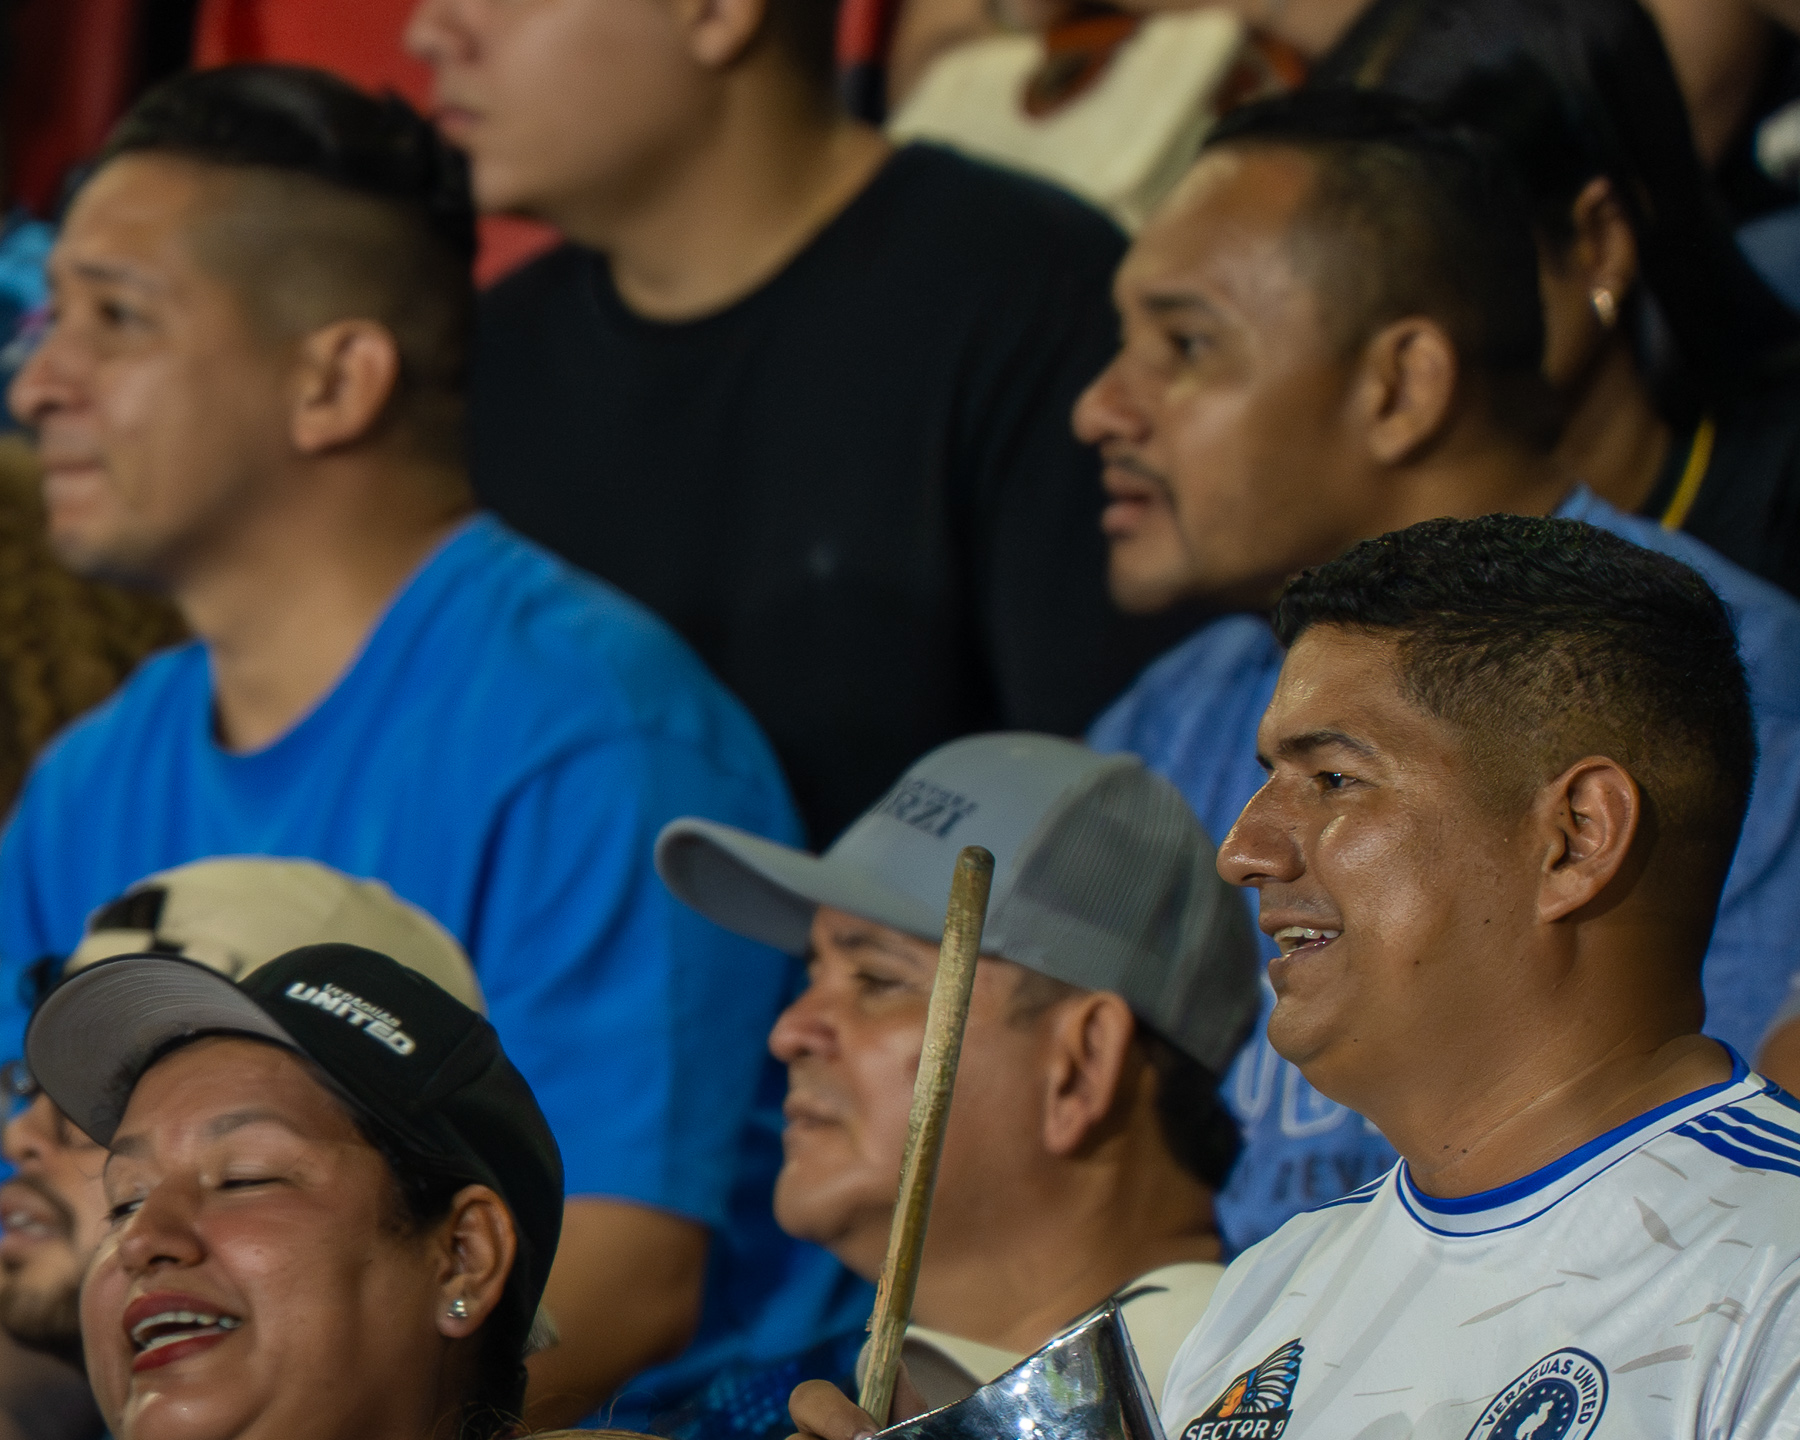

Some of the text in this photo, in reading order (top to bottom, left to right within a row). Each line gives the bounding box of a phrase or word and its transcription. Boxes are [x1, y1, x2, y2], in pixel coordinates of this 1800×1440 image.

[285, 981, 416, 1055] UNITED
[1481, 1358, 1598, 1426] VERAGUAS UNITED
[1271, 1419, 1286, 1439] 9
